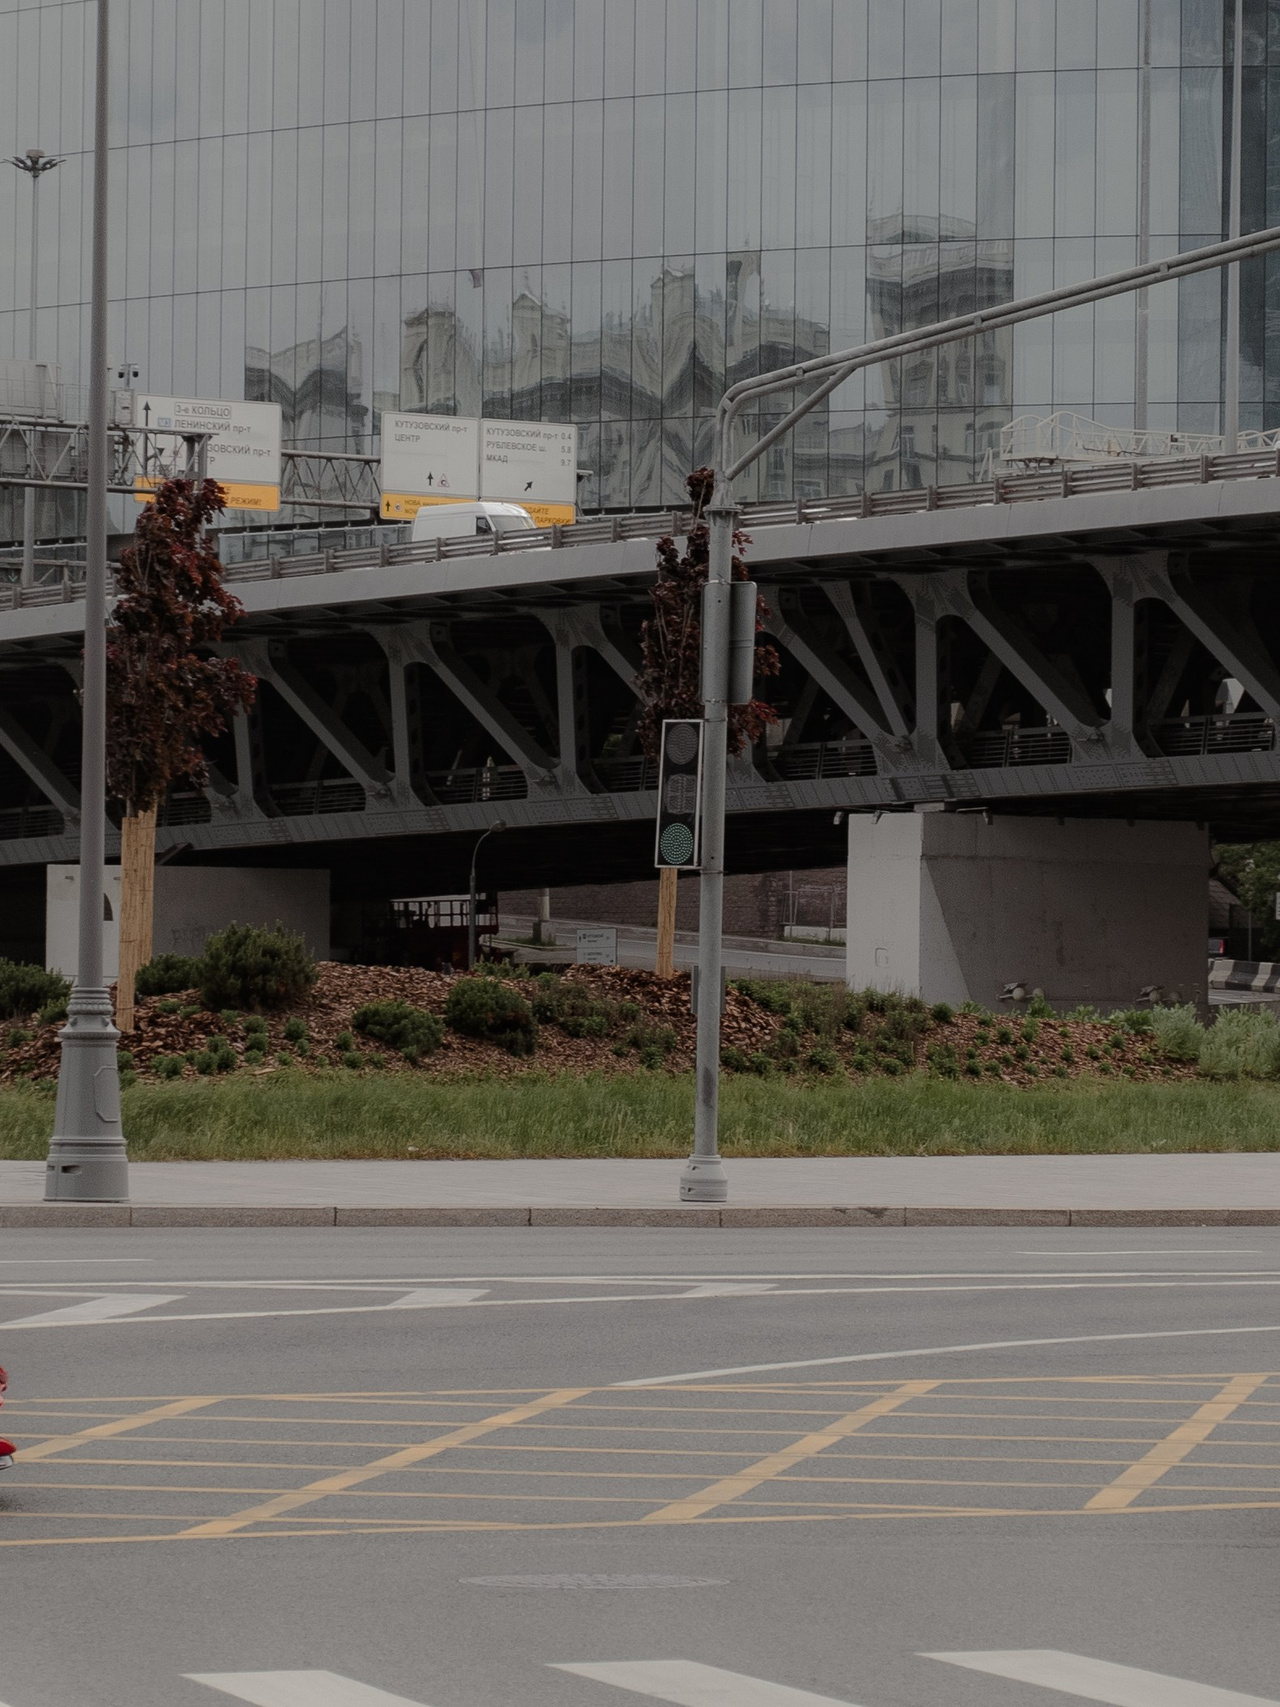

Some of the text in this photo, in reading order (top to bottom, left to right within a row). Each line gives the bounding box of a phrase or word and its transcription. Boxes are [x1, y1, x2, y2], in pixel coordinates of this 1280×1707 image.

[191, 405, 230, 417] КОЛЬЦО
[174, 419, 230, 431] ЛЕНИНСКИЙ
[233, 425, 251, 434] пр-т
[394, 420, 467, 434] КУТУЗОВСКИЙ пр-т
[394, 433, 420, 442] ЦЕНТР
[486, 427, 541, 438] КУТУЗОВСКИЙ
[543, 433, 558, 441] пр-т
[206, 443, 271, 457] ЗОВСКИЙ пр-т
[486, 440, 537, 451] РУБЛЕВСКОЕ
[486, 454, 508, 463] МКАД
